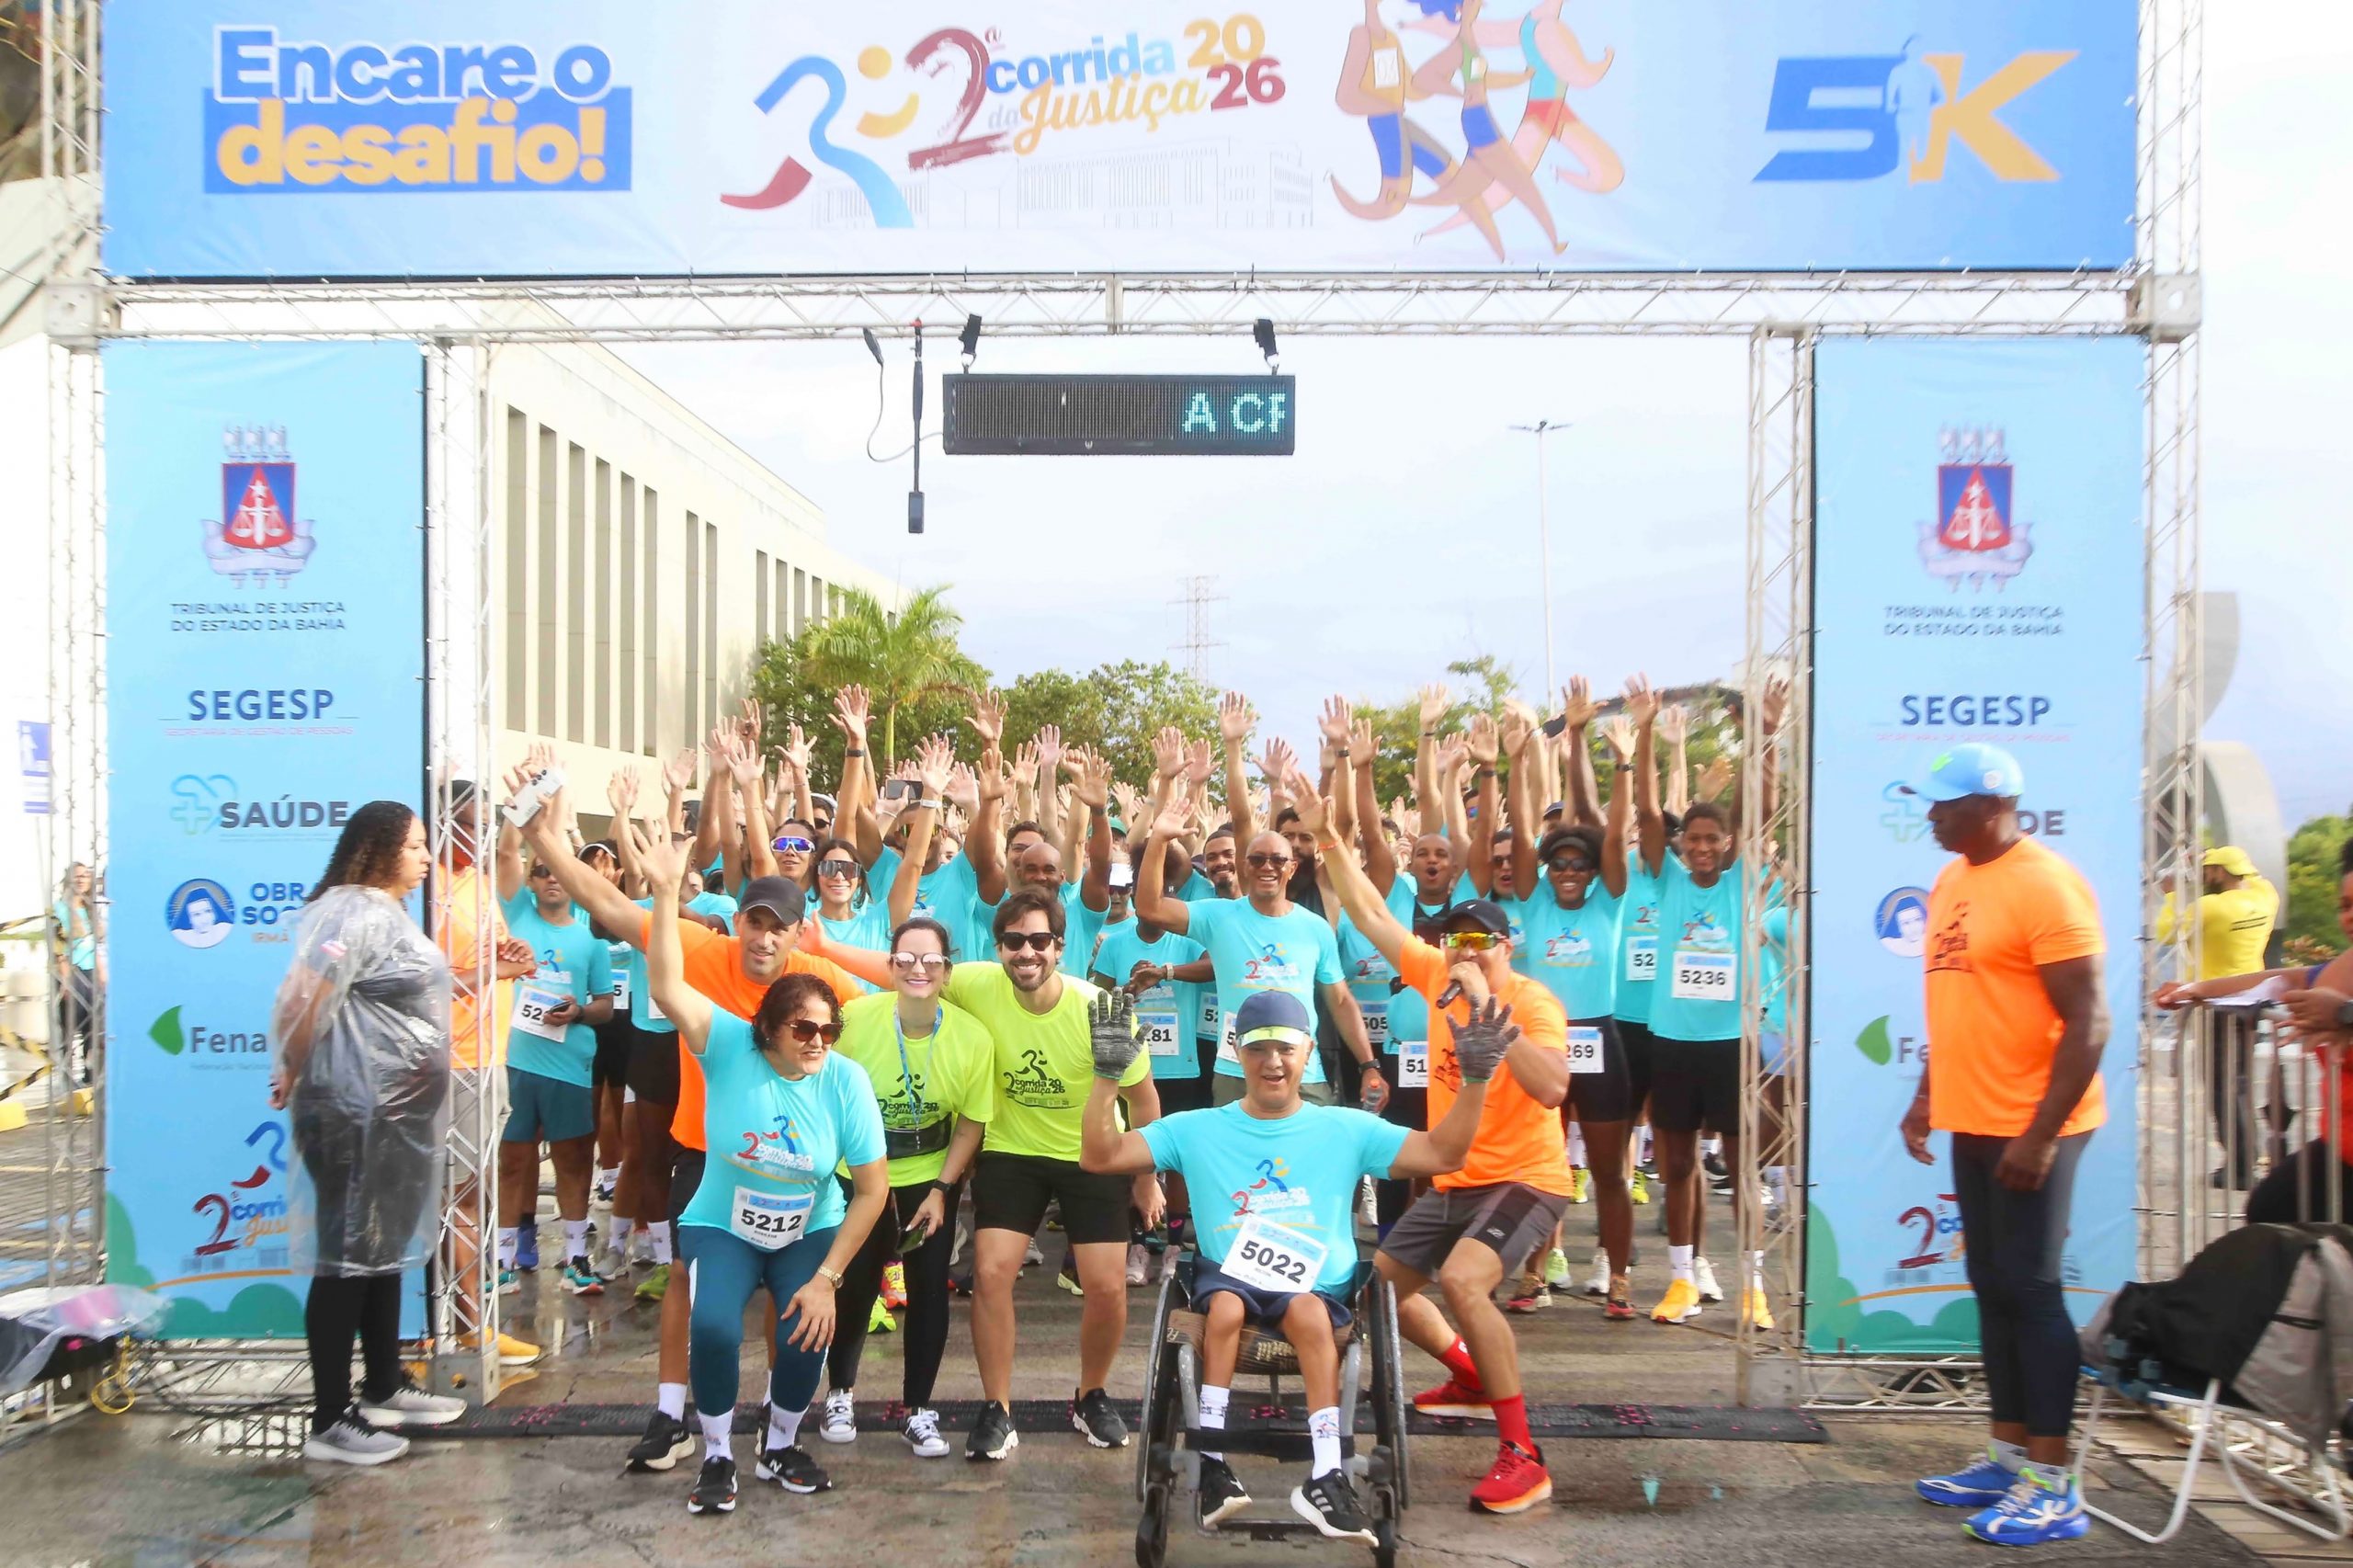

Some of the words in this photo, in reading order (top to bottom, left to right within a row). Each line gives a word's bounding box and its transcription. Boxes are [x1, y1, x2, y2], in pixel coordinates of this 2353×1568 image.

[214, 25, 538, 105] Encare
[552, 42, 614, 104] o
[985, 31, 1176, 93] corrida
[1184, 13, 1266, 69] 20
[987, 103, 1021, 131] da
[1013, 74, 1208, 157] Justiça
[1206, 55, 1287, 112] 26
[1750, 50, 2081, 187] 5K
[217, 96, 607, 186] desafio!
[1182, 392, 1217, 434] A
[170, 602, 250, 615] TRIBUNAL
[256, 602, 277, 614] DE
[280, 602, 346, 617] JUSTIÇA
[1884, 605, 1968, 619] TRIBUNAL
[1970, 606, 1994, 619] DE
[170, 619, 194, 632] DO
[200, 619, 263, 631] ESTADO
[268, 619, 290, 631] DA
[295, 619, 346, 631] BAHIA
[1884, 623, 1910, 636] DO
[1914, 623, 1980, 636] ESTADO
[1983, 623, 2007, 636] DA
[2011, 623, 2064, 636] BAHIA
[188, 689, 334, 722] SEGESP
[1901, 695, 2052, 726] SEGESP
[220, 793, 349, 829] SAÚDE
[242, 905, 298, 926] SO
[1633, 953, 1654, 967] 52
[1679, 969, 1726, 986] 5236
[521, 1004, 543, 1021] 52
[190, 1027, 268, 1054] Fena
[1146, 1028, 1172, 1042] 81
[1406, 1059, 1427, 1074] 51
[741, 1208, 802, 1233] 5212
[1240, 1240, 1306, 1284] 5022
